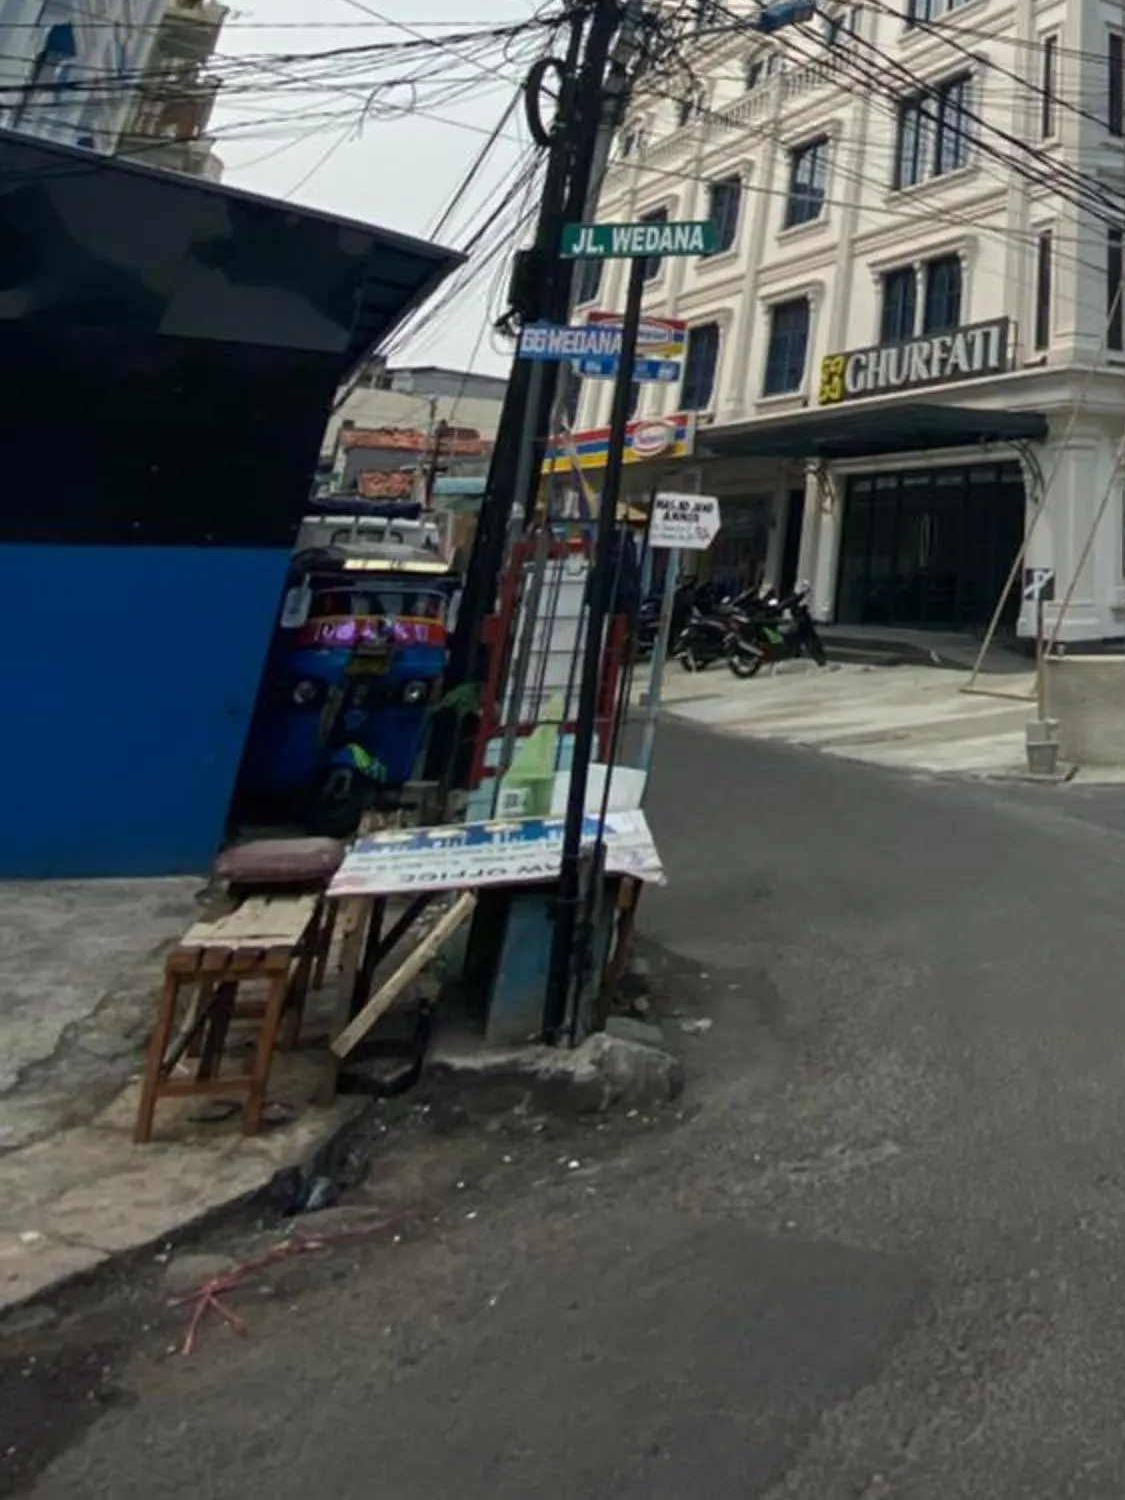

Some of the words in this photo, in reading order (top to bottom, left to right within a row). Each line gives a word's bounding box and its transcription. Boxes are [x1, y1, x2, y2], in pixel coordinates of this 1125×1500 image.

[572, 229, 605, 254] JL.
[611, 225, 704, 252] WEDANA
[845, 325, 1000, 392] GHURFATI
[517, 863, 561, 878] AW
